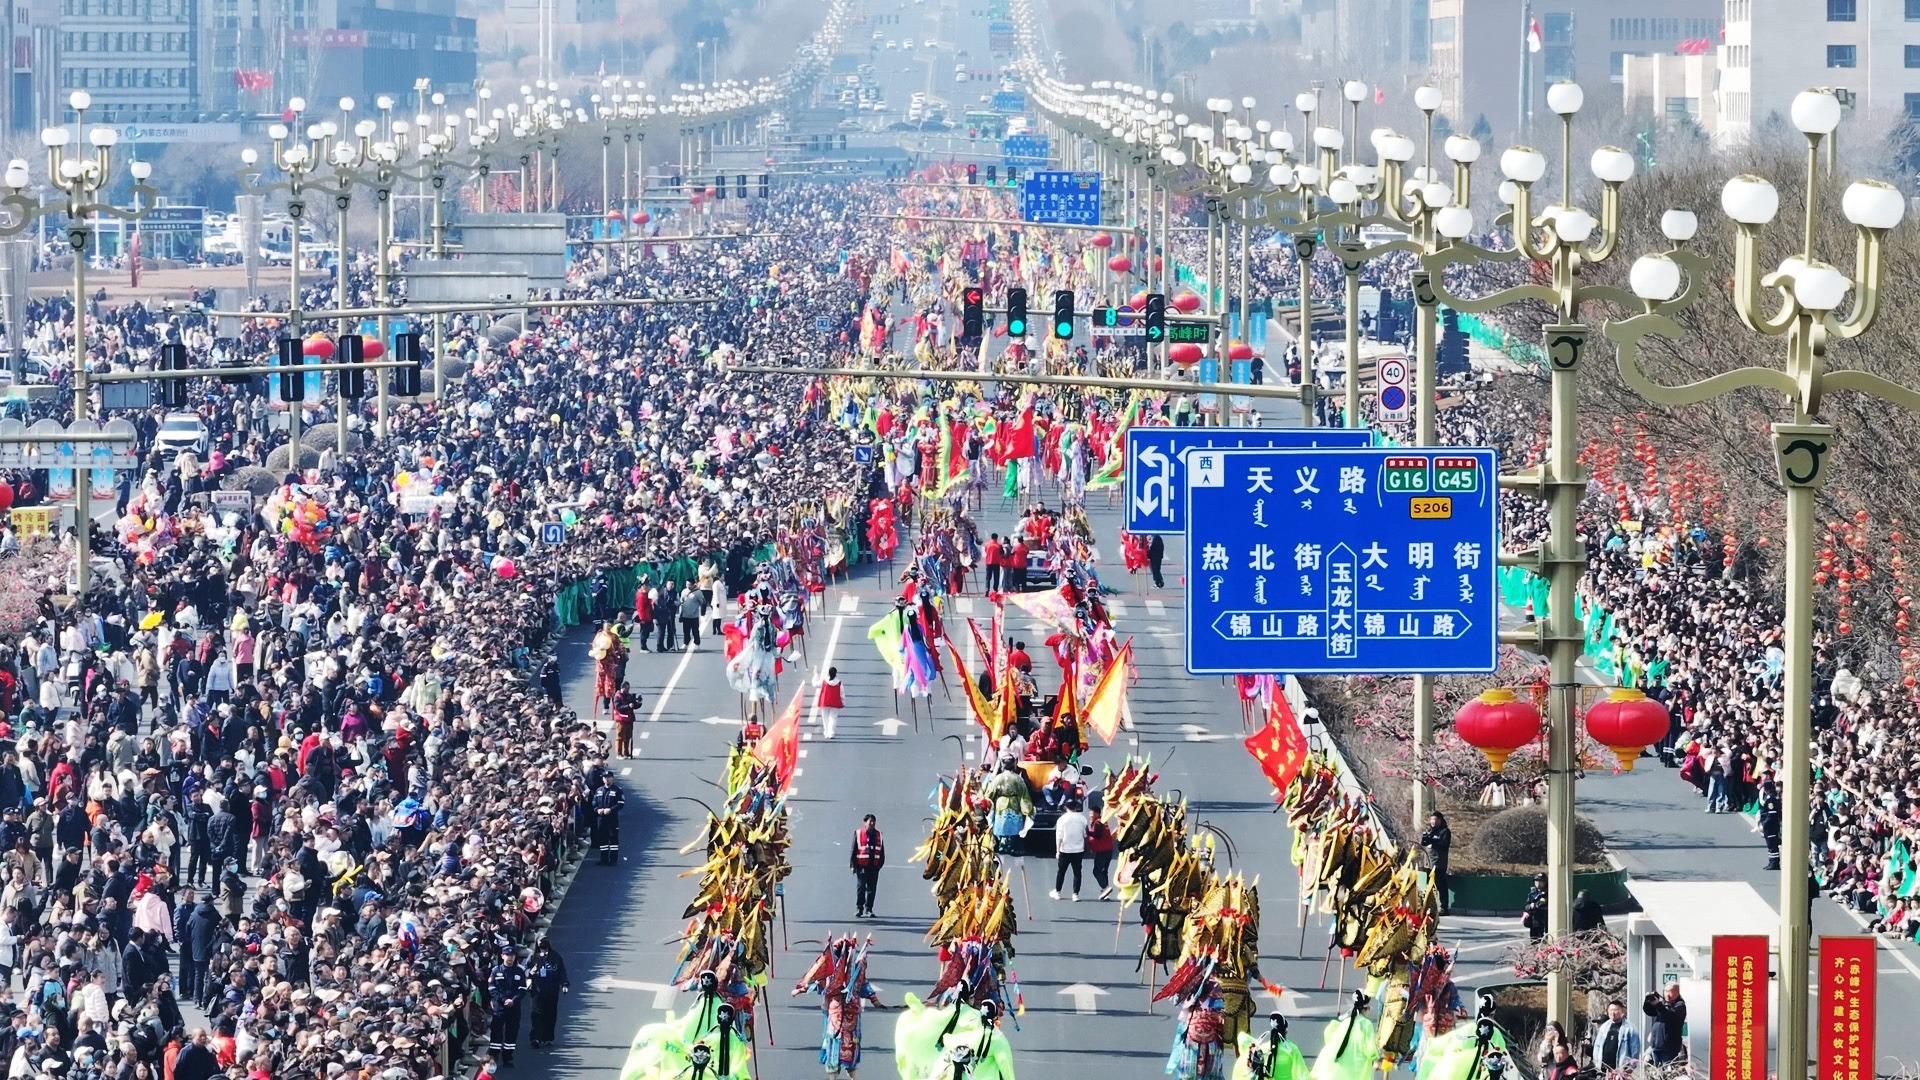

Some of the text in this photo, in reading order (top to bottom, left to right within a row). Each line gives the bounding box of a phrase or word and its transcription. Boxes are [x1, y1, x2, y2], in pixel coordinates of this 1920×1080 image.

[1105, 307, 1117, 327] 8
[1386, 367, 1400, 378] 40
[1199, 456, 1213, 470] 西
[1246, 465, 1367, 494] 天义路
[1389, 471, 1424, 489] G16
[1438, 471, 1473, 489] G45
[1413, 503, 1449, 514] S206
[1201, 542, 1322, 571] 热北街
[1361, 541, 1482, 570] 大明街
[1330, 562, 1353, 655] 玉龙大街
[1229, 613, 1319, 637] 锦山路
[1363, 613, 1456, 637] 锦山路
[1725, 956, 1738, 1080] 积极推进国家级农牧文化
[1833, 957, 1845, 1080] 齐心共建农牧文化
